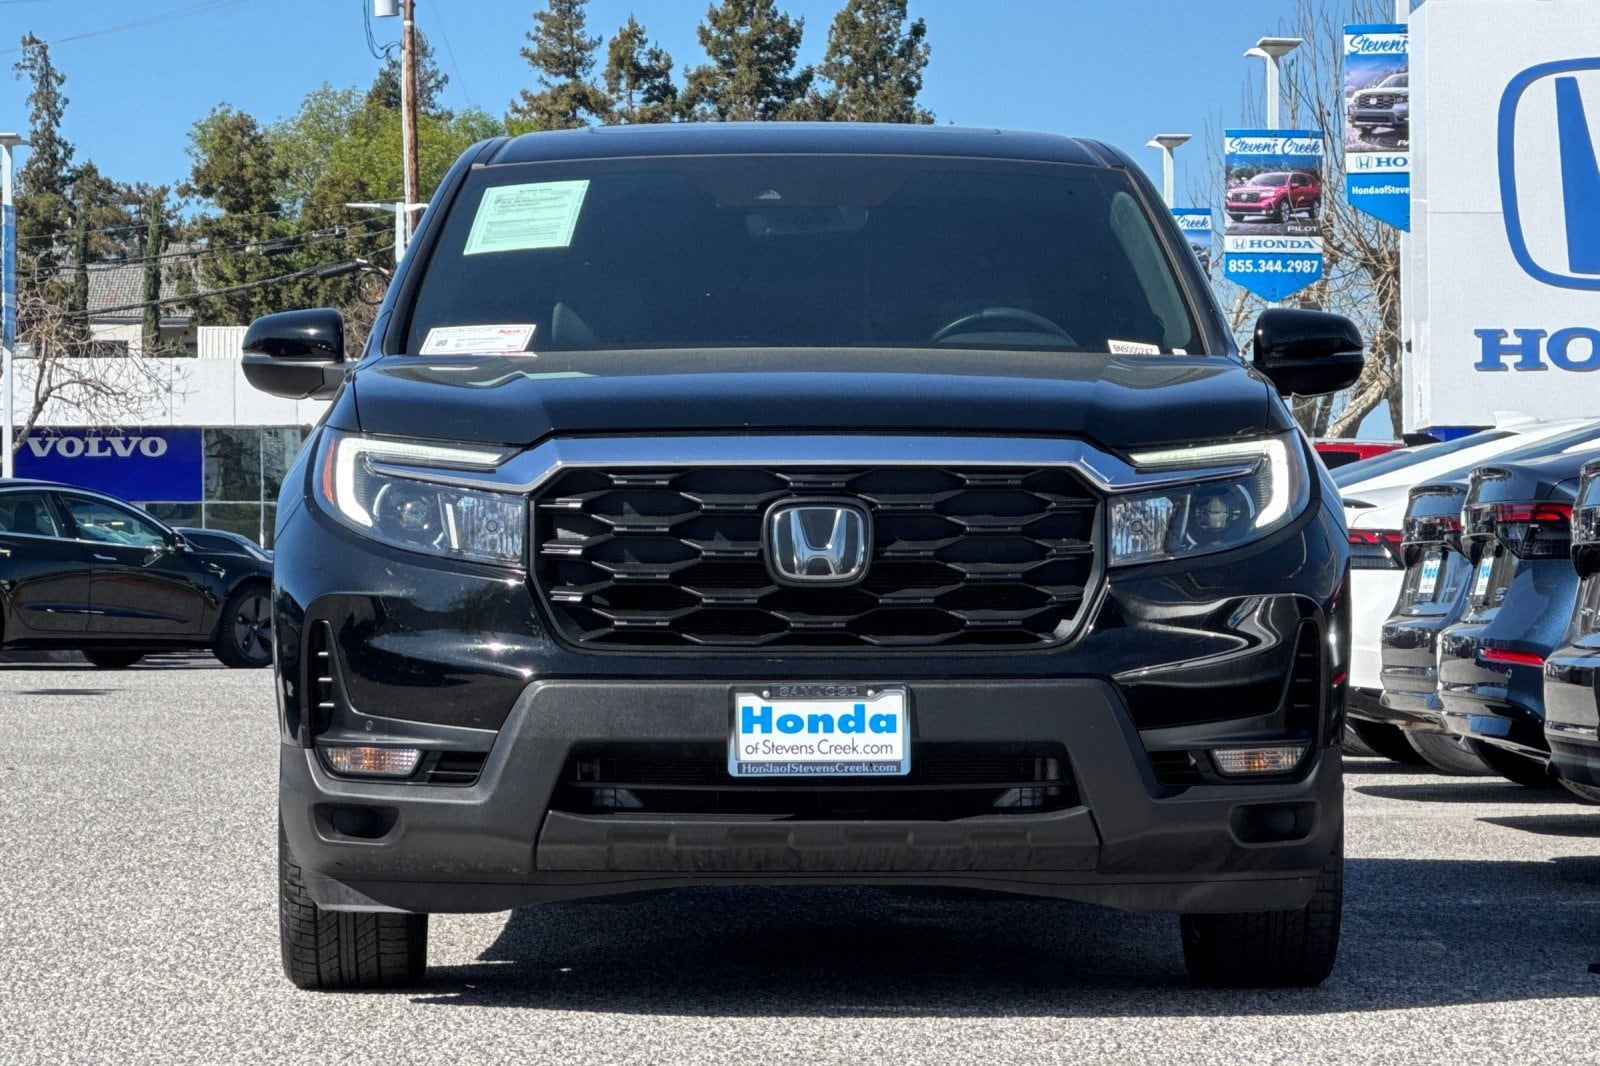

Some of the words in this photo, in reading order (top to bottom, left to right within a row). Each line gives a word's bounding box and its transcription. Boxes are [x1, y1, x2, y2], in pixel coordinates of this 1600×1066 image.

[1348, 34, 1408, 54] Stevens
[1228, 137, 1277, 155] Stevens
[1282, 137, 1320, 155] Creek
[1375, 157, 1409, 167] HO
[1249, 240, 1314, 249] HONDA
[1228, 259, 1319, 273] 855.344.2987
[1474, 327, 1600, 372] HO
[27, 436, 168, 458] VOLVO
[742, 703, 897, 734] Honda
[745, 743, 760, 755] of
[762, 739, 815, 755] Stevens
[817, 737, 893, 755] Creek.com
[742, 763, 897, 774] HondaofStevensCreek.com
